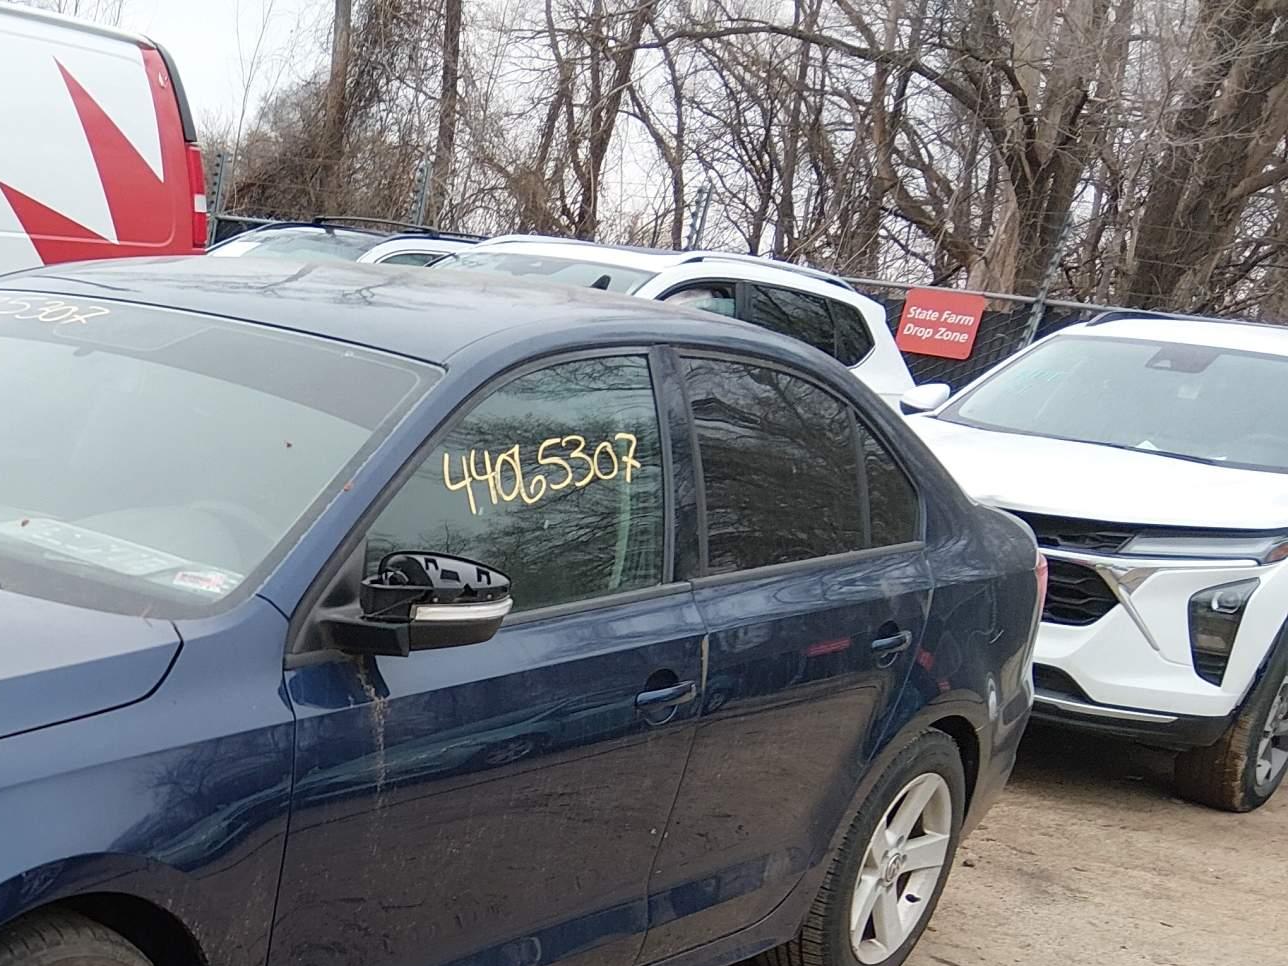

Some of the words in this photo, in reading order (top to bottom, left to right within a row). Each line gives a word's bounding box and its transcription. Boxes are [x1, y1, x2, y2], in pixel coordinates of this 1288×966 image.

[907, 306, 939, 321] State
[941, 310, 975, 326] Farm
[903, 323, 933, 340] Drop
[934, 327, 968, 343] Zone
[443, 432, 641, 515] 44065307
